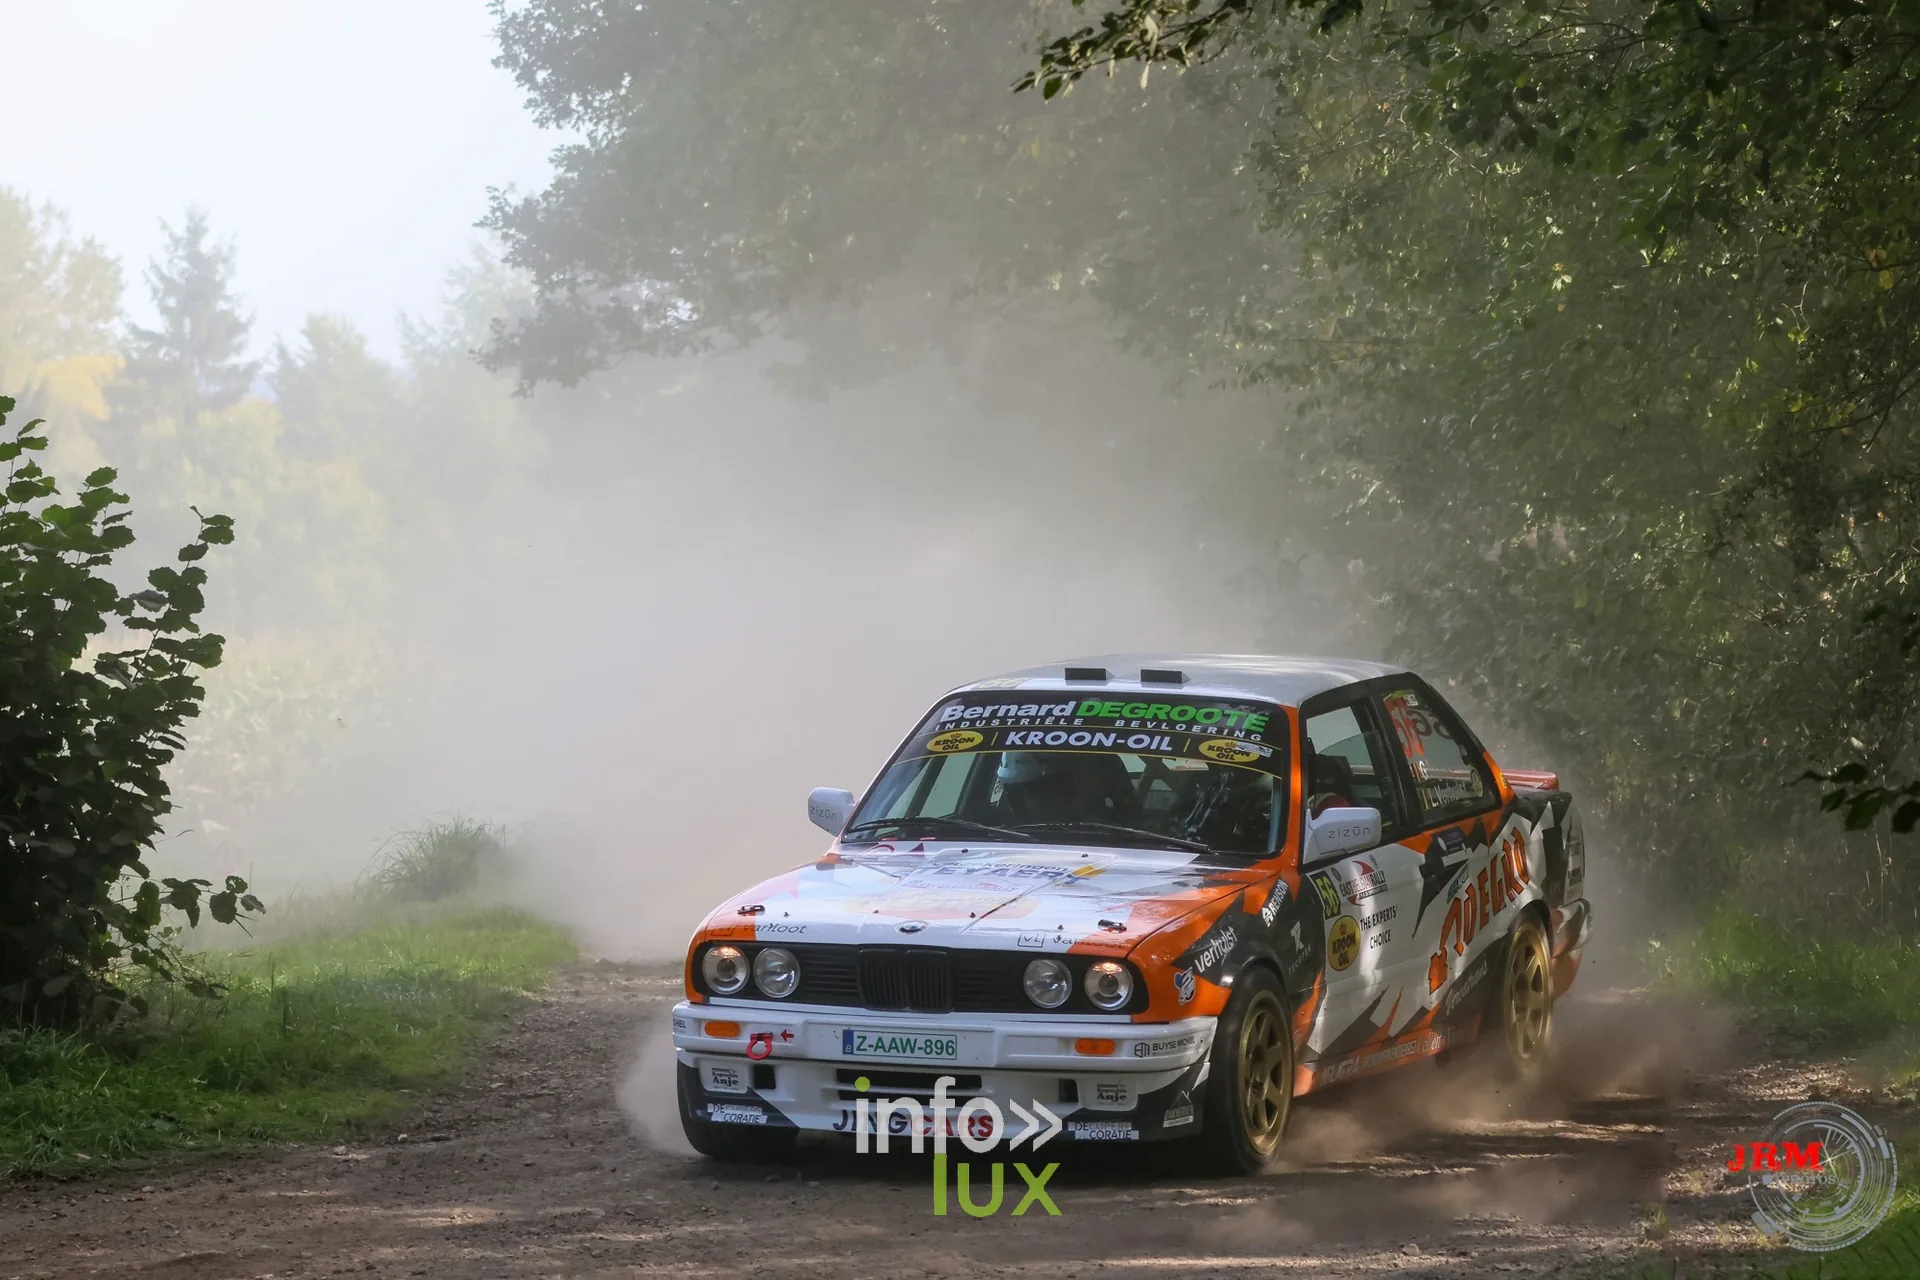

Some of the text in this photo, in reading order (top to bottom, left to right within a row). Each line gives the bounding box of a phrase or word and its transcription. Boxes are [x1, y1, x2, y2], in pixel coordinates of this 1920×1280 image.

[939, 701, 1269, 732] Bernard DEGROOTE
[935, 716, 1262, 741] INDUSTRIËLE BEVLOERING
[934, 735, 976, 745] KROON
[1005, 731, 1173, 751] KROON-OIL
[1216, 753, 1236, 761] OIL
[1269, 879, 1289, 916] RENSON
[1316, 876, 1340, 917] 56
[1360, 919, 1371, 932] THE
[1195, 925, 1238, 973] verhulst
[1332, 932, 1356, 955] KROON
[1369, 929, 1391, 949] CHOICE
[855, 1035, 956, 1057] Z-AAW-896
[1153, 1040, 1177, 1051] BUYSE
[713, 1076, 738, 1087] Anje
[1097, 1091, 1127, 1102] Anje
[724, 1113, 760, 1123] CORATIE
[1089, 1130, 1132, 1140] CORATIE
